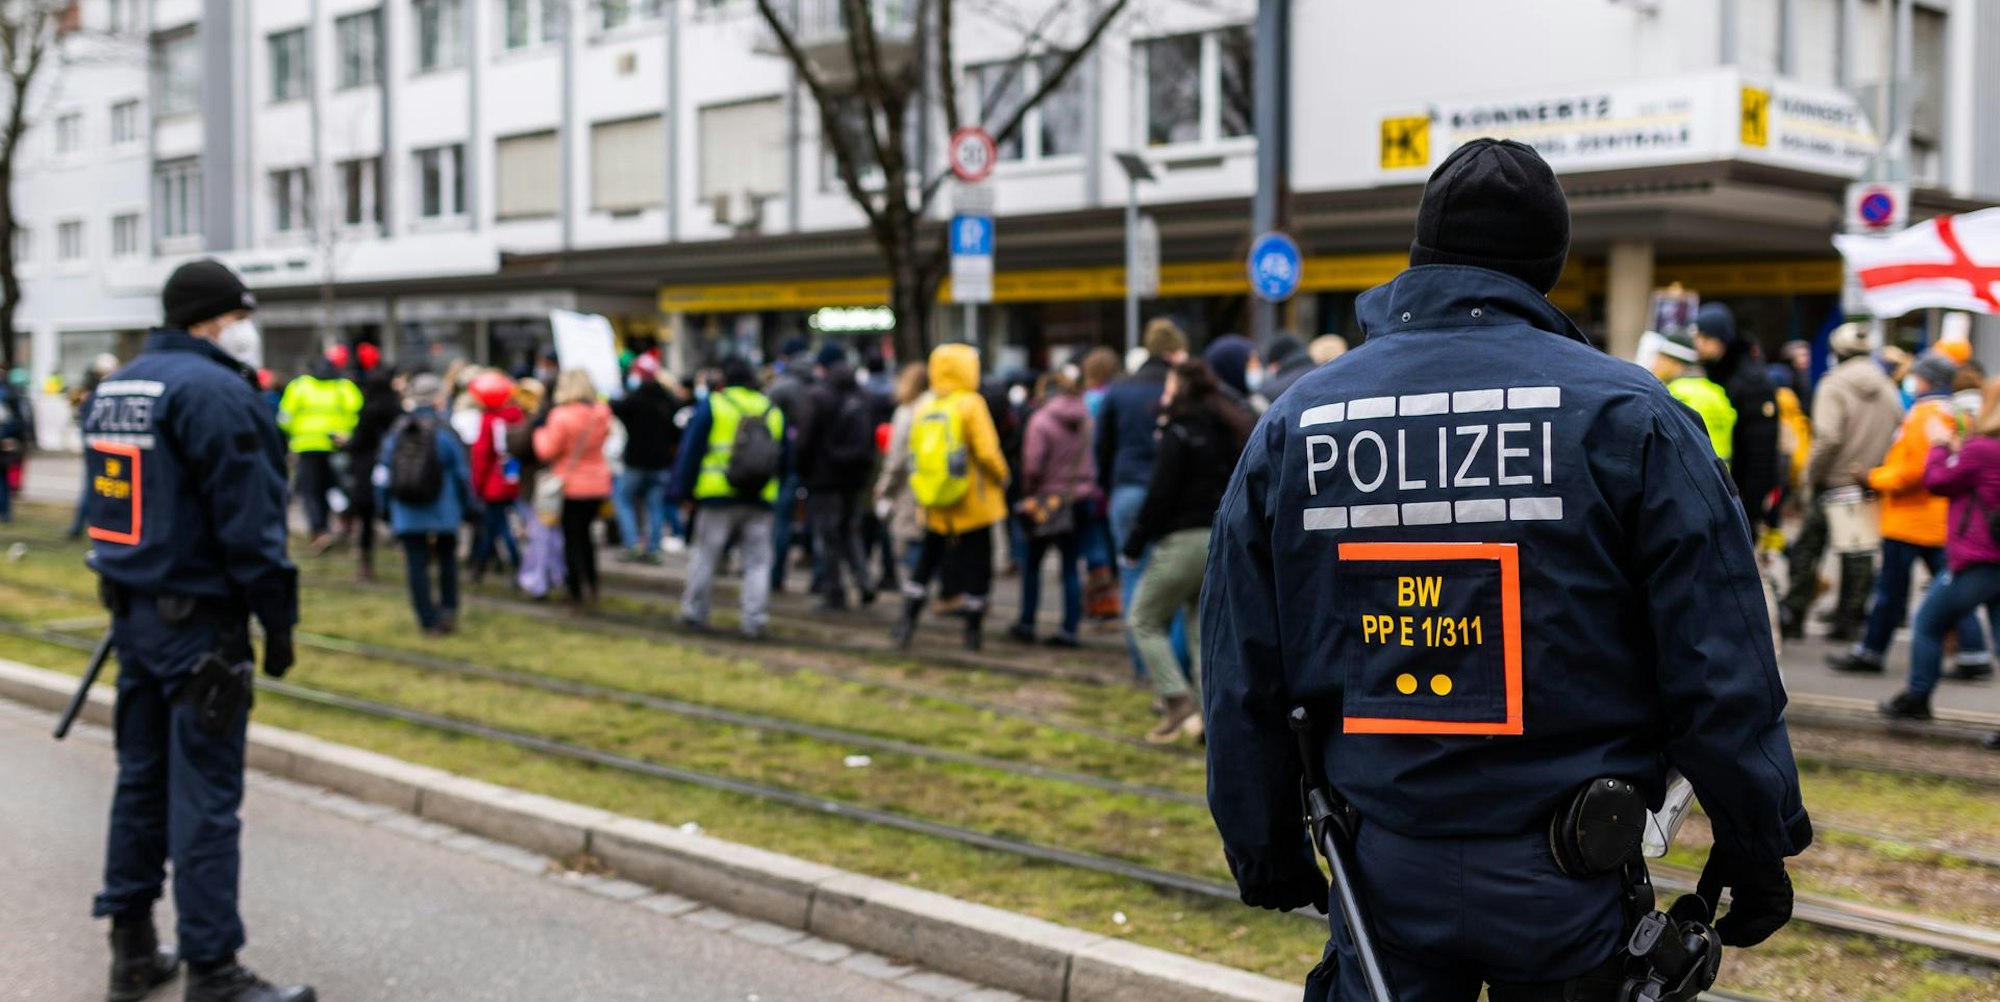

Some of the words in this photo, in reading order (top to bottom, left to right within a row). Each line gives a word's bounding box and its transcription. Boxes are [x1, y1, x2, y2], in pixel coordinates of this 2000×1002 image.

[85, 397, 154, 431] POLIZEI
[1305, 421, 1553, 496] POLIZEI
[1398, 576, 1443, 607] BW
[1361, 614, 1395, 645] PP
[1400, 616, 1414, 646] E
[1421, 615, 1483, 648] 1/311
